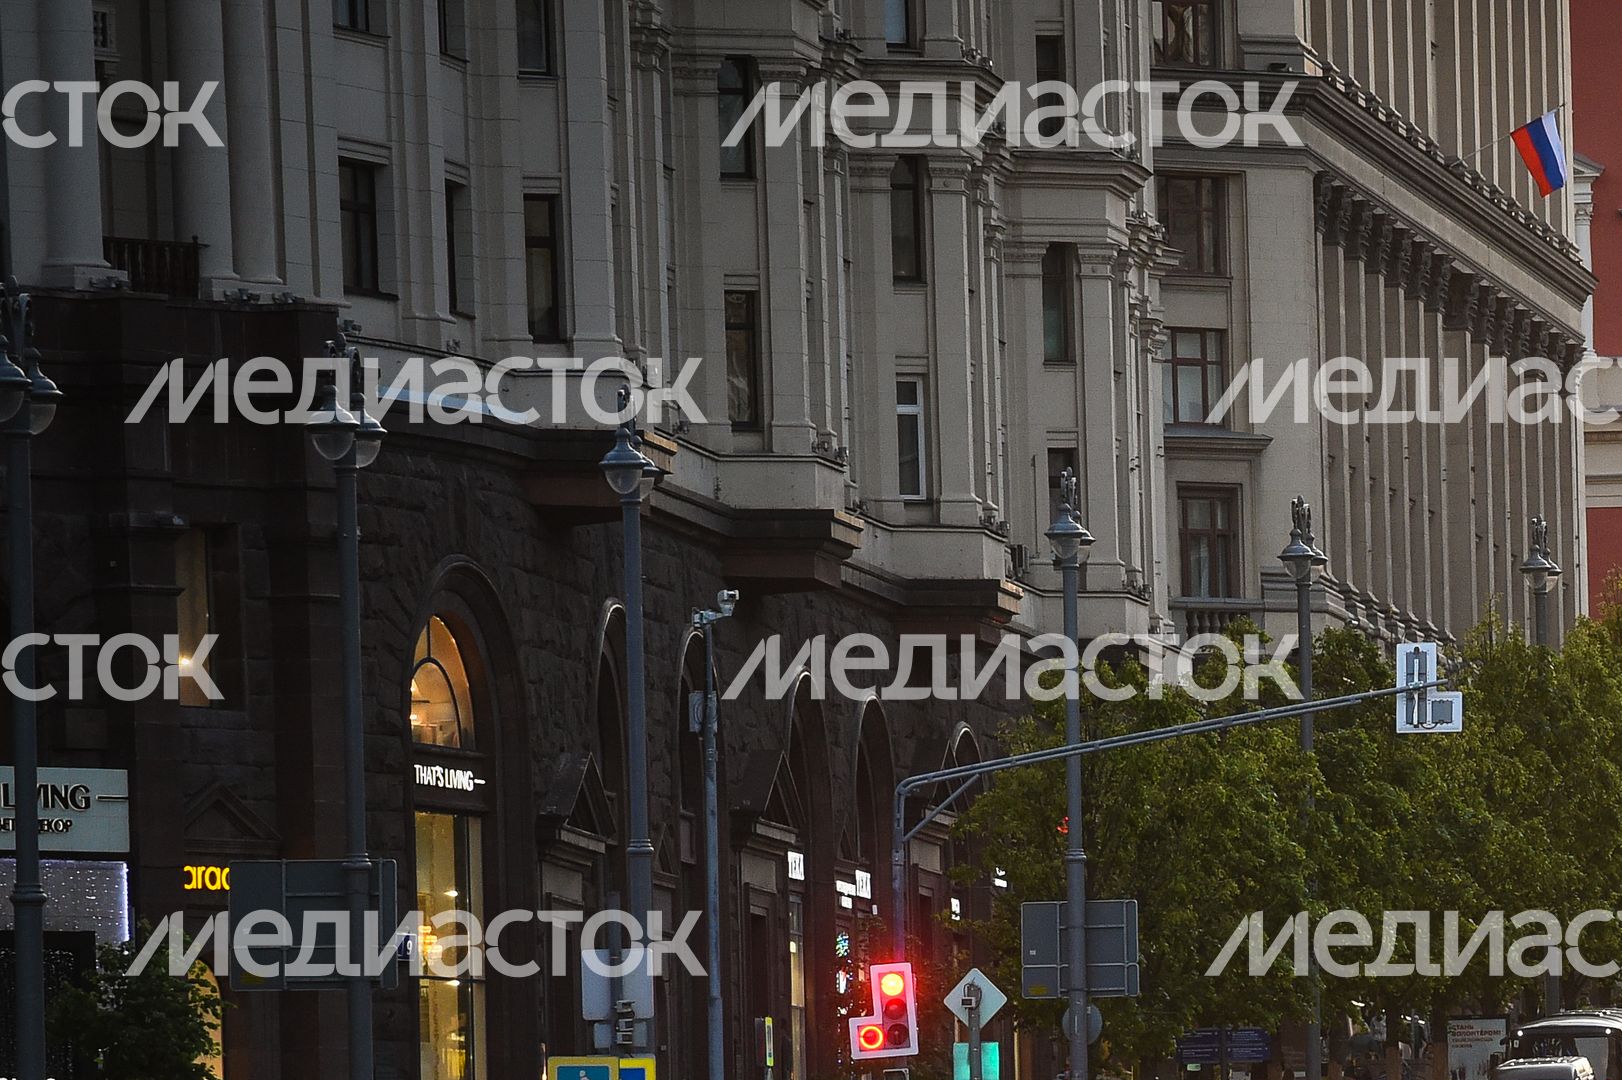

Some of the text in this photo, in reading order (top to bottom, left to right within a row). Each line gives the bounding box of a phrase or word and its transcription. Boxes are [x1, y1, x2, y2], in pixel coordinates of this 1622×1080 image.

[414, 764, 475, 792] THAT'S LIVING
[0, 783, 91, 811] LING
